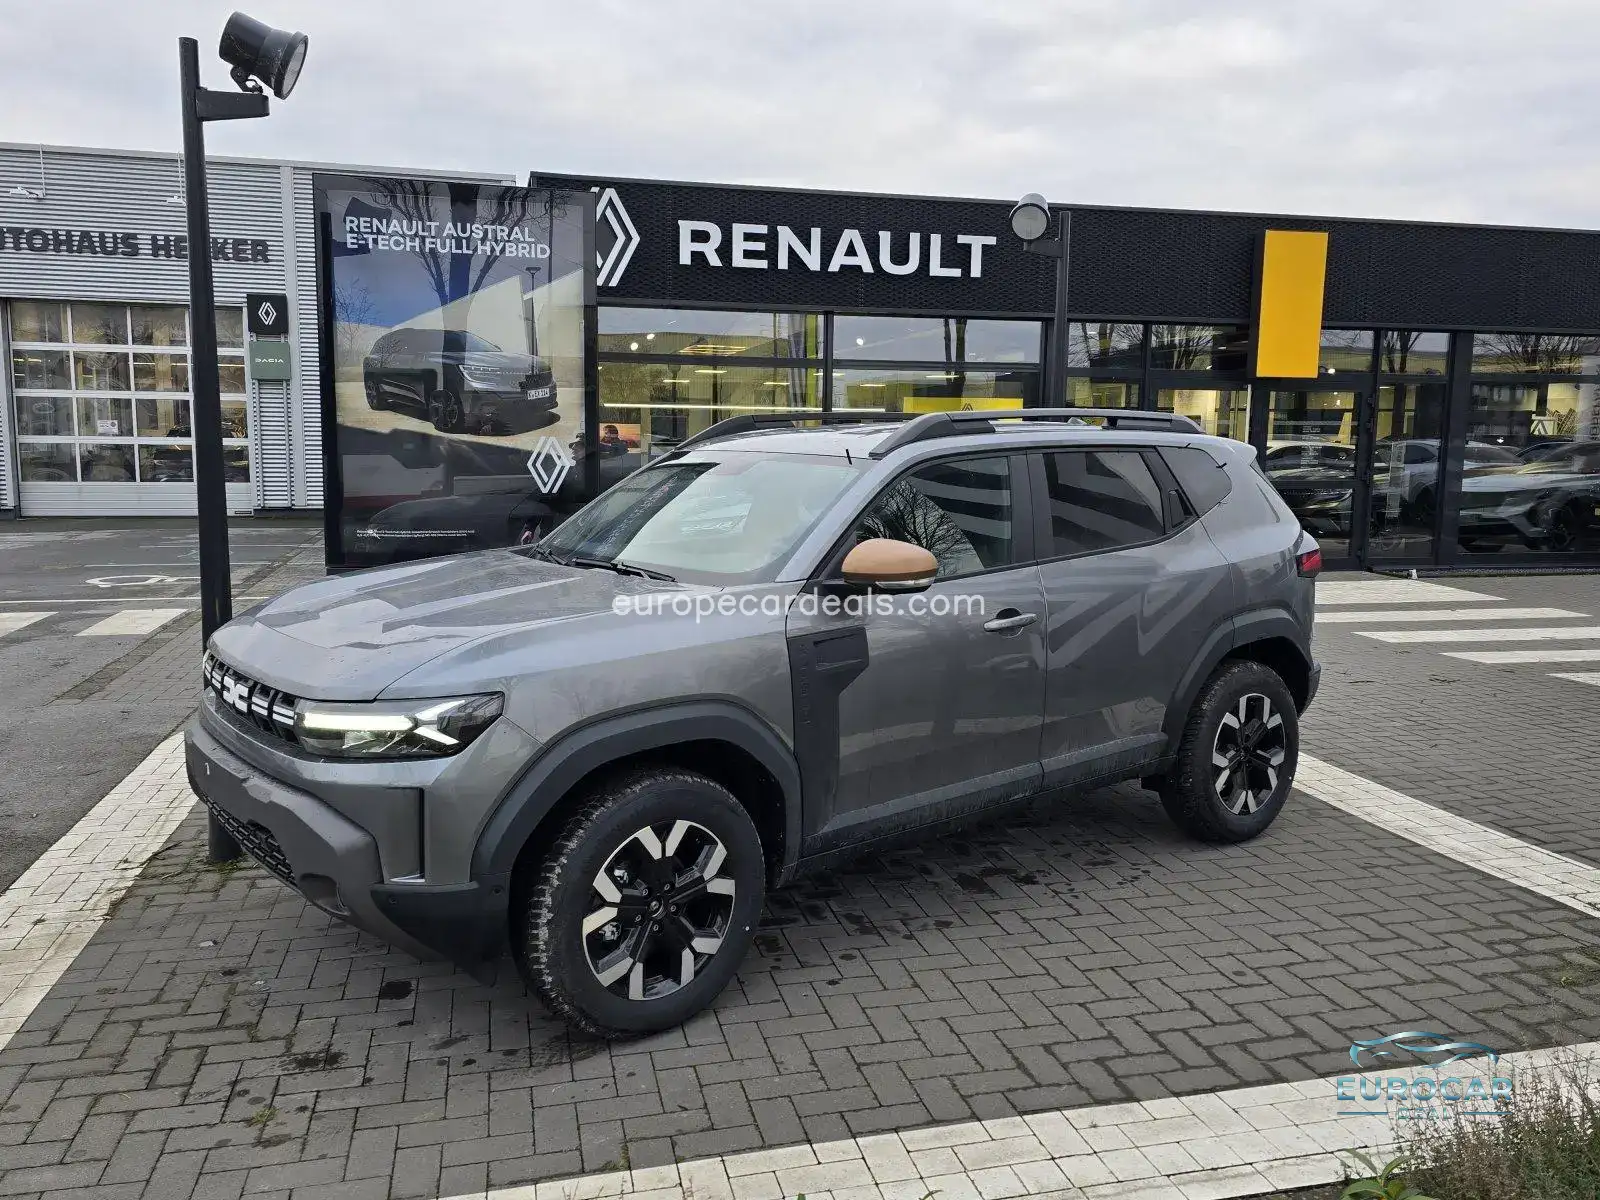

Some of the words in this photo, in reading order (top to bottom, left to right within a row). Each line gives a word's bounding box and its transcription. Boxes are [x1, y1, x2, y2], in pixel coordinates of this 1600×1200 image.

[345, 215, 440, 237] RENAULT
[442, 221, 536, 243] AUSTRAL
[150, 234, 270, 263] HEKER
[346, 232, 421, 252] E-TECH
[425, 238, 473, 255] FULL
[477, 240, 551, 259] HYBRID
[676, 219, 998, 279] RENAULT
